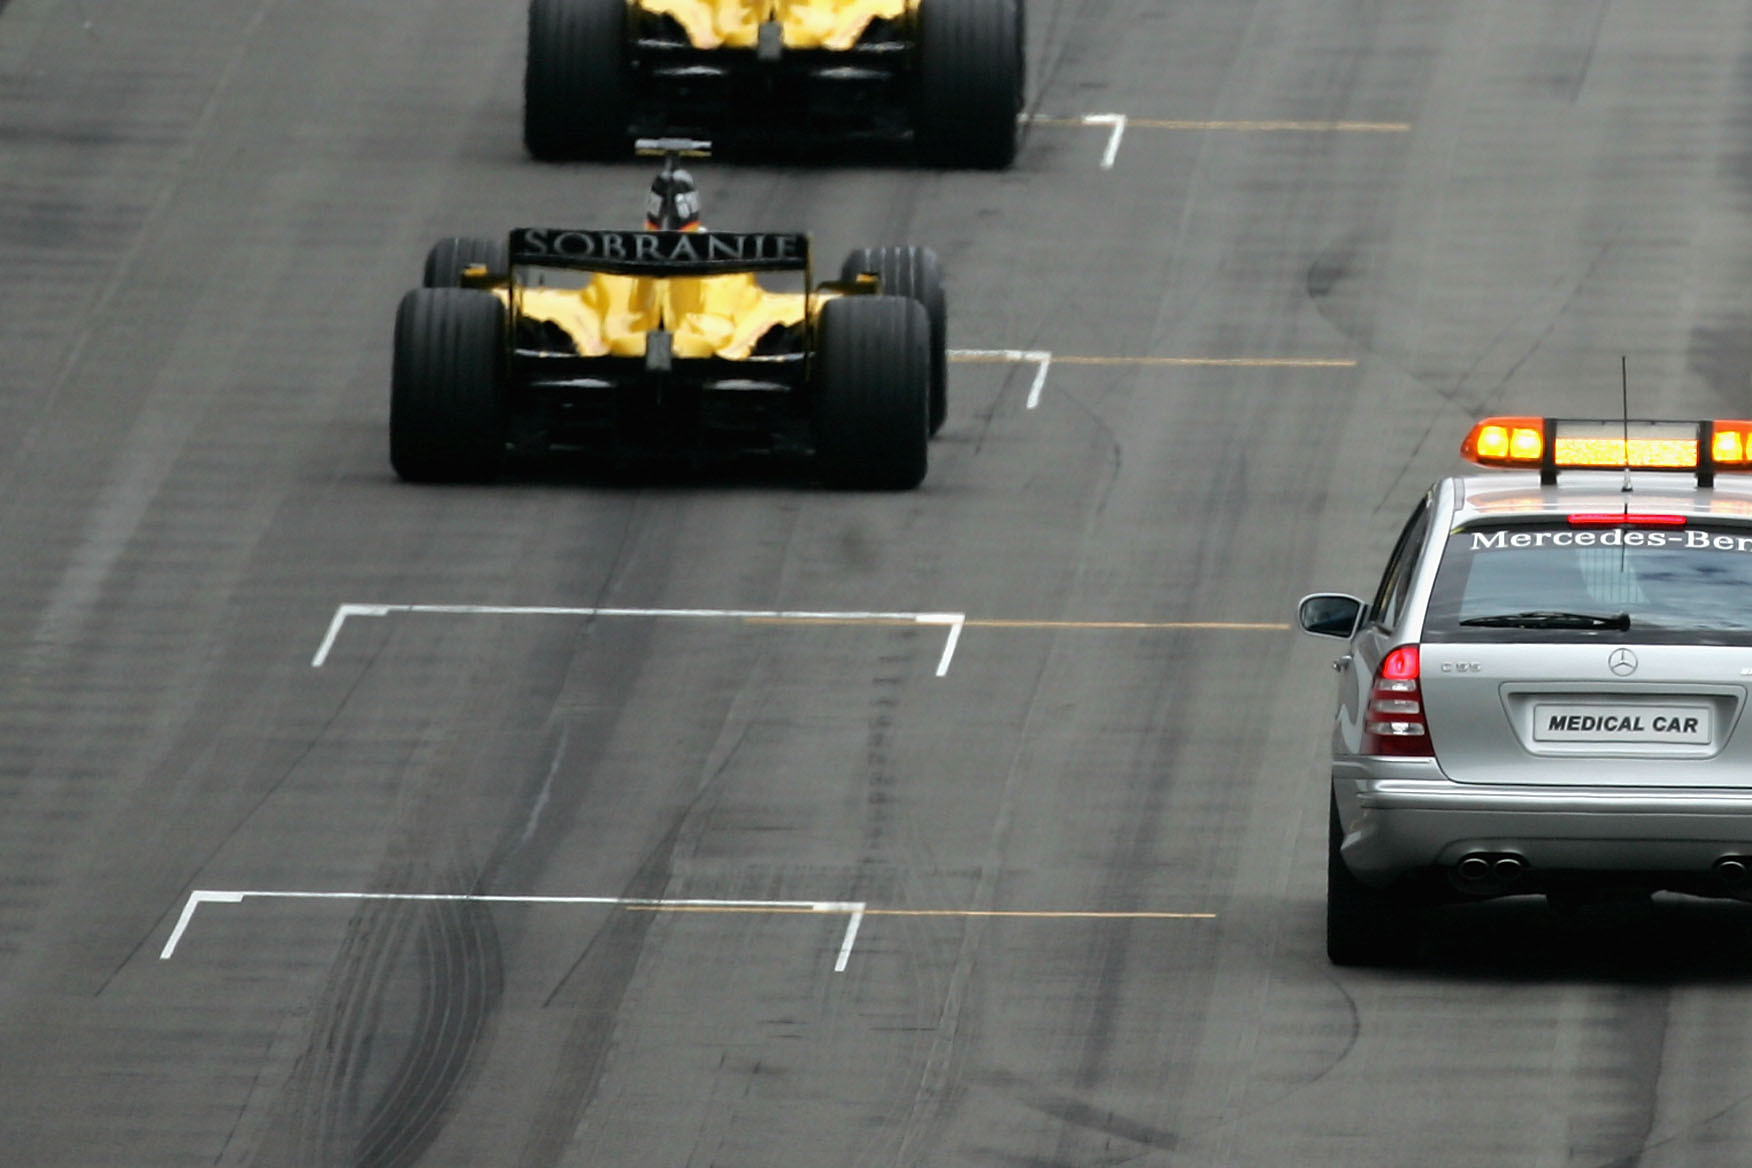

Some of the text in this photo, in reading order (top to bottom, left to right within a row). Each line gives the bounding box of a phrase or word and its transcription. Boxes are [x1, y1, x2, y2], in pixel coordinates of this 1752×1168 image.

[523, 232, 797, 261] SOBRANIE
[1548, 715, 1699, 733] MEDICAL CAR
